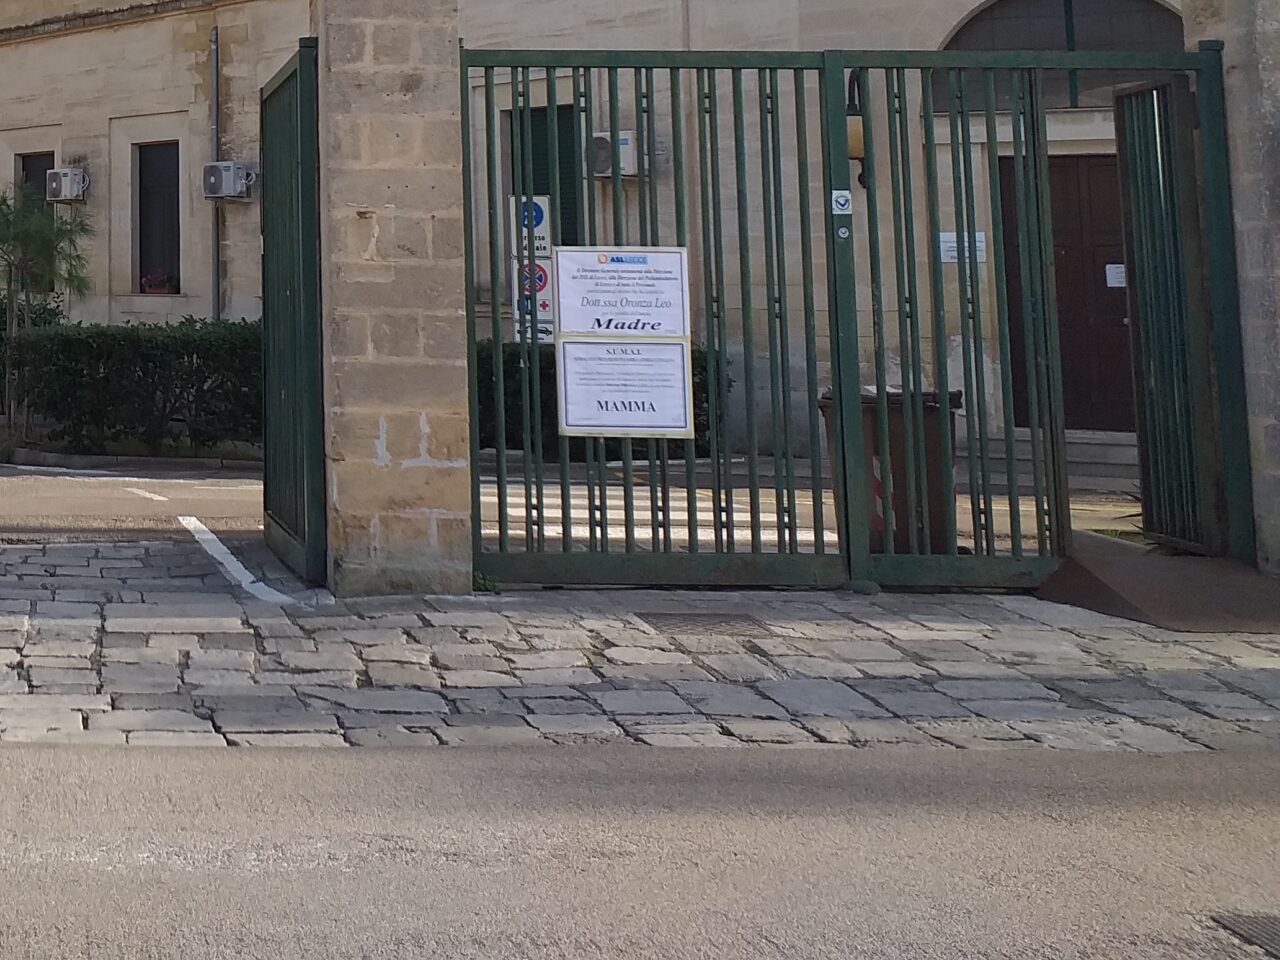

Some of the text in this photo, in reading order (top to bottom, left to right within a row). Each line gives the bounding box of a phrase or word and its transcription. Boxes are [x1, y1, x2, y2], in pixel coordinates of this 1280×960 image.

[620, 297, 652, 308] Oronza
[654, 297, 672, 308] Leo
[591, 318, 662, 331] Madre
[596, 400, 657, 413] MAMMA
